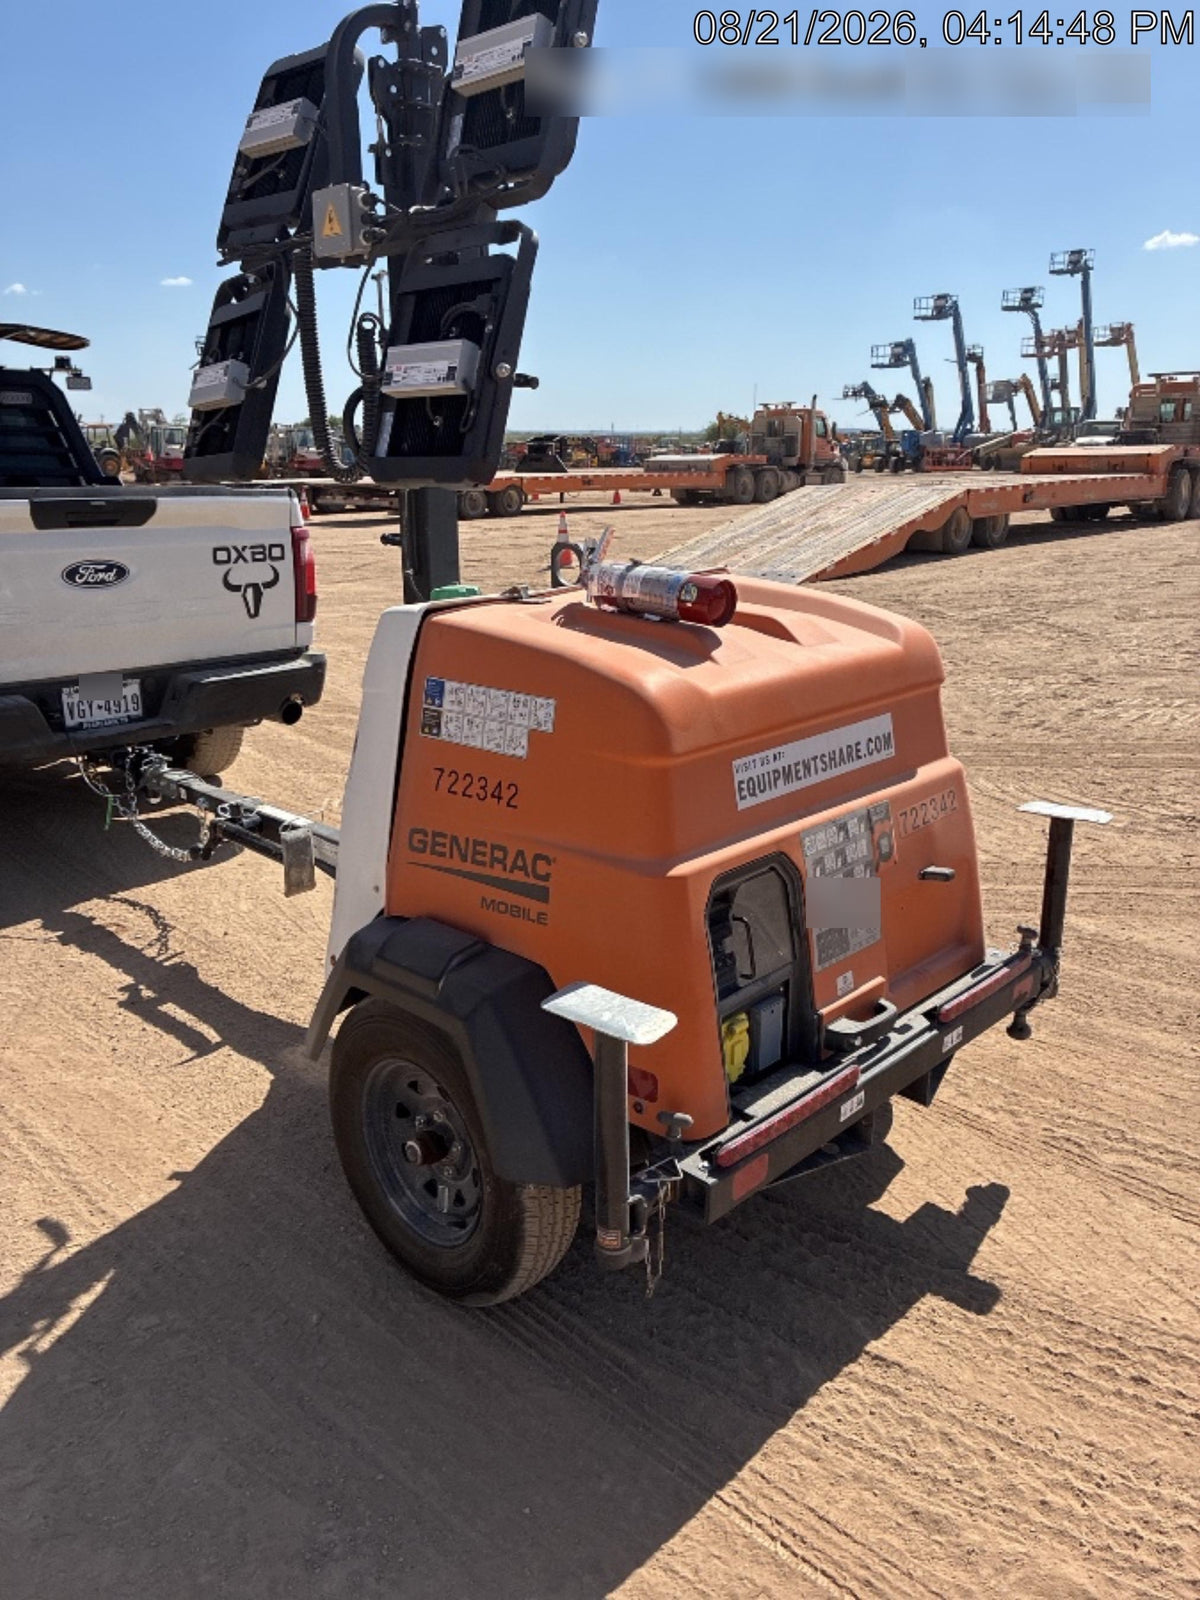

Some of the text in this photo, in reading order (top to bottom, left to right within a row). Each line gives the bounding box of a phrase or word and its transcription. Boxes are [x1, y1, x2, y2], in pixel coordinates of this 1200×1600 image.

[74, 563, 119, 585] Ford
[433, 766, 520, 809] 722342
[737, 731, 894, 801] EQUIPMENTSHARE.COM
[899, 789, 958, 835] 722342
[407, 827, 552, 883] GENERAC
[480, 895, 549, 926] MOBILE
